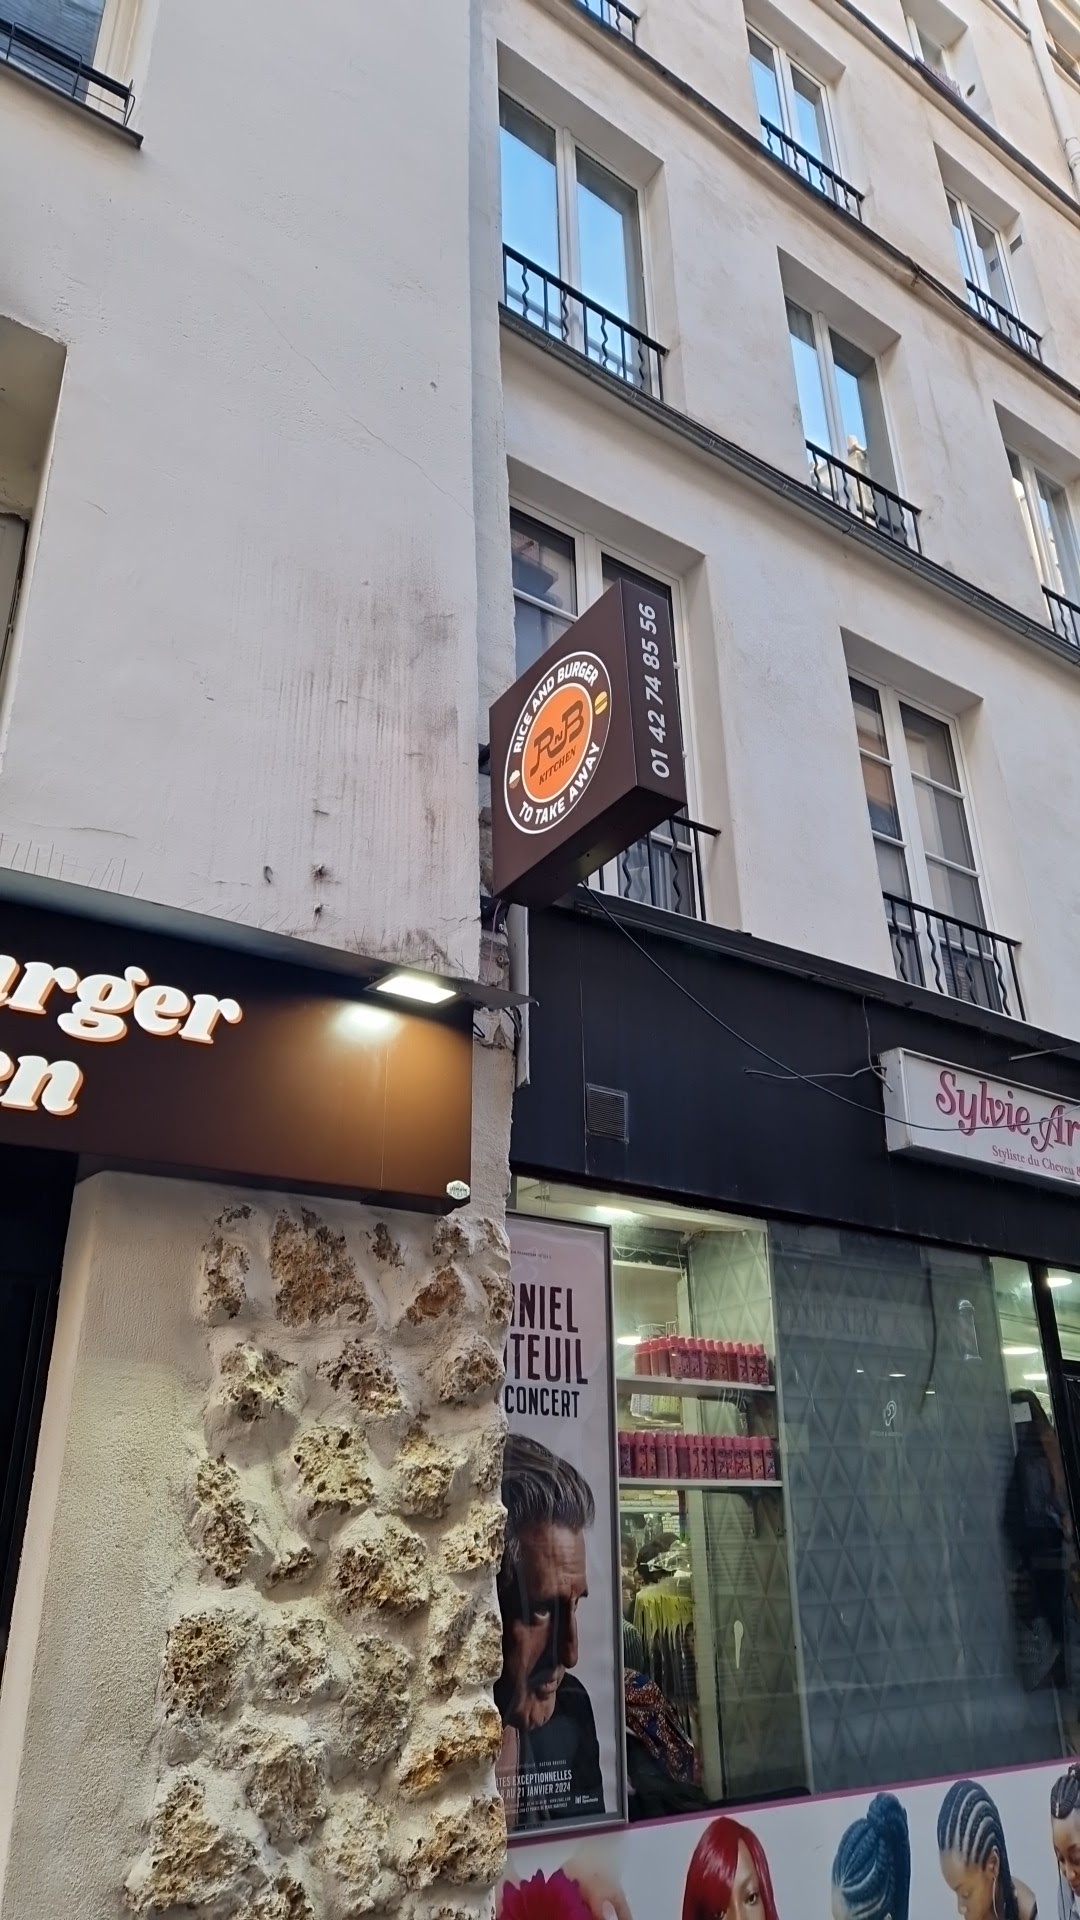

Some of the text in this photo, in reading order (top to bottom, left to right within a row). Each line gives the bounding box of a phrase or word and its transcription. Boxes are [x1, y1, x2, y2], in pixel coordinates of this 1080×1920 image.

[513, 661, 599, 753] RICE AND BURGER
[638, 602, 670, 778] 01 42 74 85 56
[519, 741, 600, 825] TO TAKE AWAY
[538, 745, 577, 786] KITCHEN
[936, 1070, 1031, 1136] Sylvie
[992, 1144, 1026, 1162] Styliste
[1028, 1154, 1040, 1167] du
[1042, 1158, 1074, 1176] Cheveu
[504, 1385, 580, 1418] CONCERT
[506, 1787, 516, 1799] AU
[517, 1786, 525, 1798] 21
[526, 1783, 554, 1797] JANVIER
[555, 1781, 571, 1794] 2024
[512, 1769, 573, 1786] EXCEPTIONNELLES
